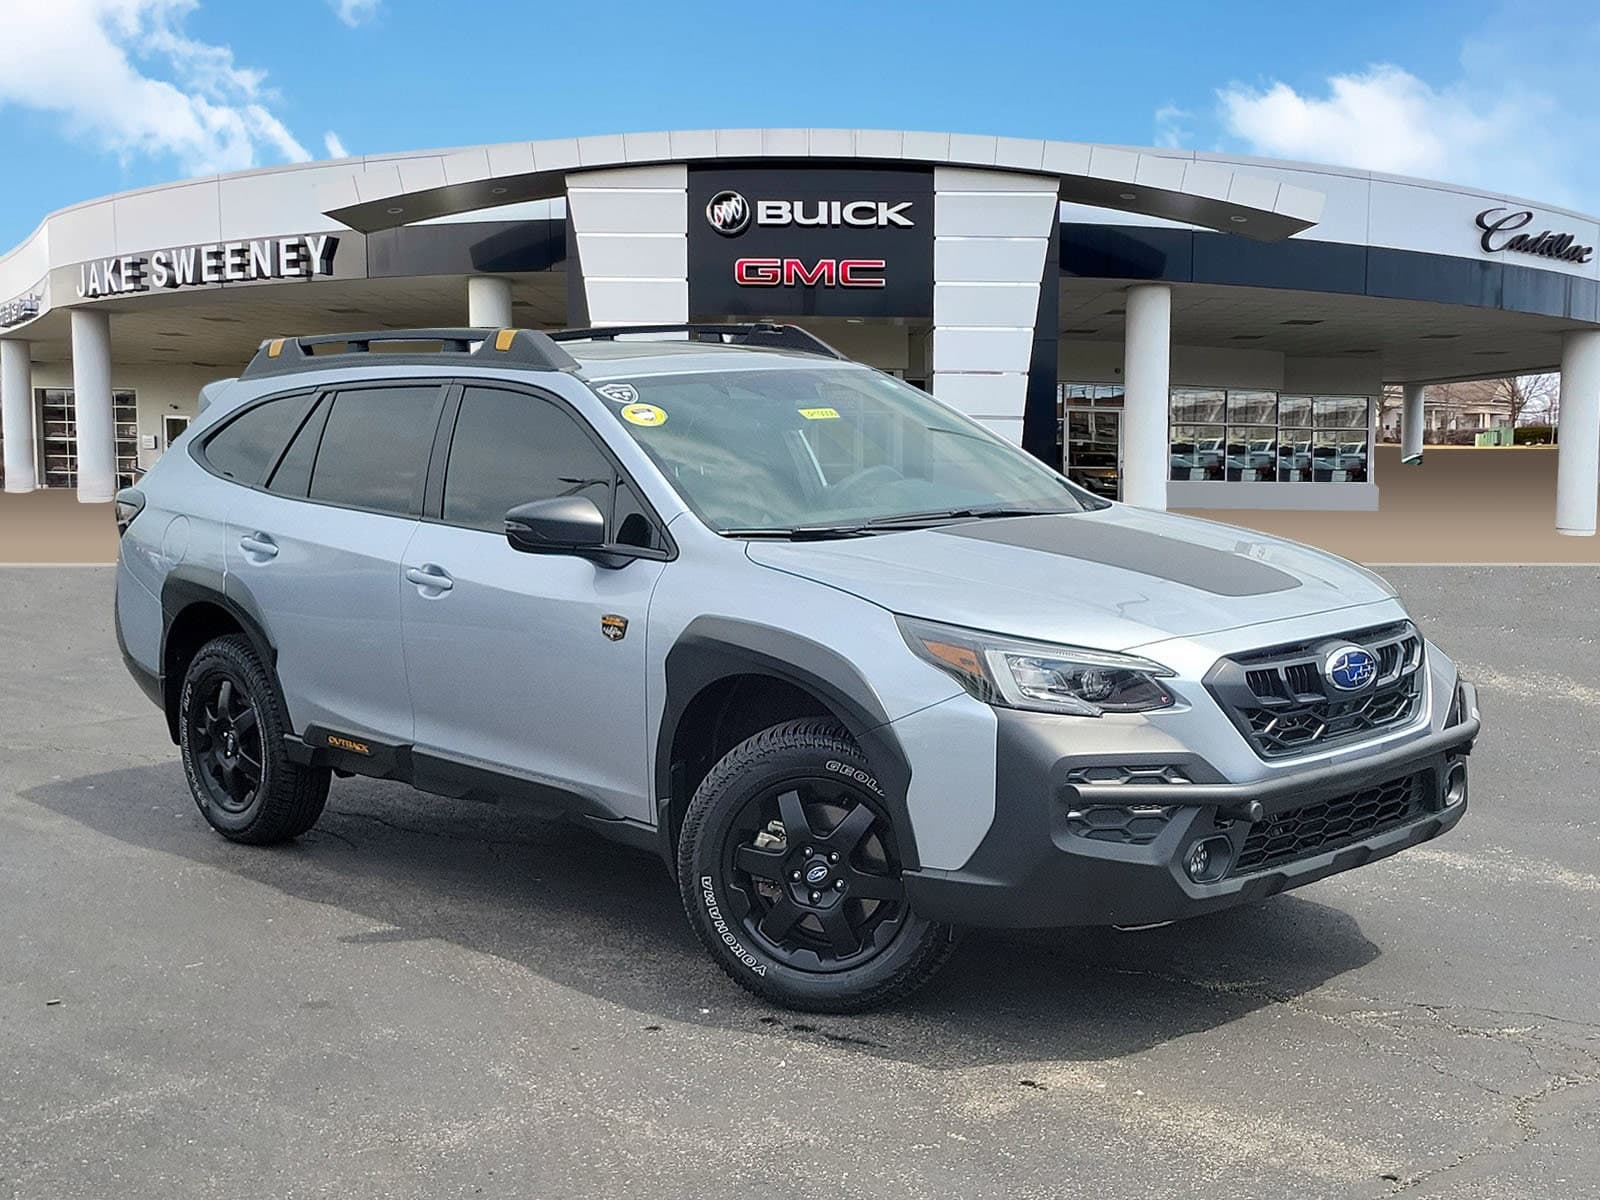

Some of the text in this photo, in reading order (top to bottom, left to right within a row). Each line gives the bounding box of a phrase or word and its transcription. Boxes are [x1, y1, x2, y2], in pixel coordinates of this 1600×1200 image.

[757, 200, 915, 227] BUICK
[1475, 207, 1593, 264] Cadillac
[76, 235, 333, 298] JAKE SWEENEY
[735, 258, 886, 288] GMC
[328, 735, 369, 753] OUTBACK
[825, 760, 885, 797] GEOL
[701, 876, 767, 977] YOKOHAMA
